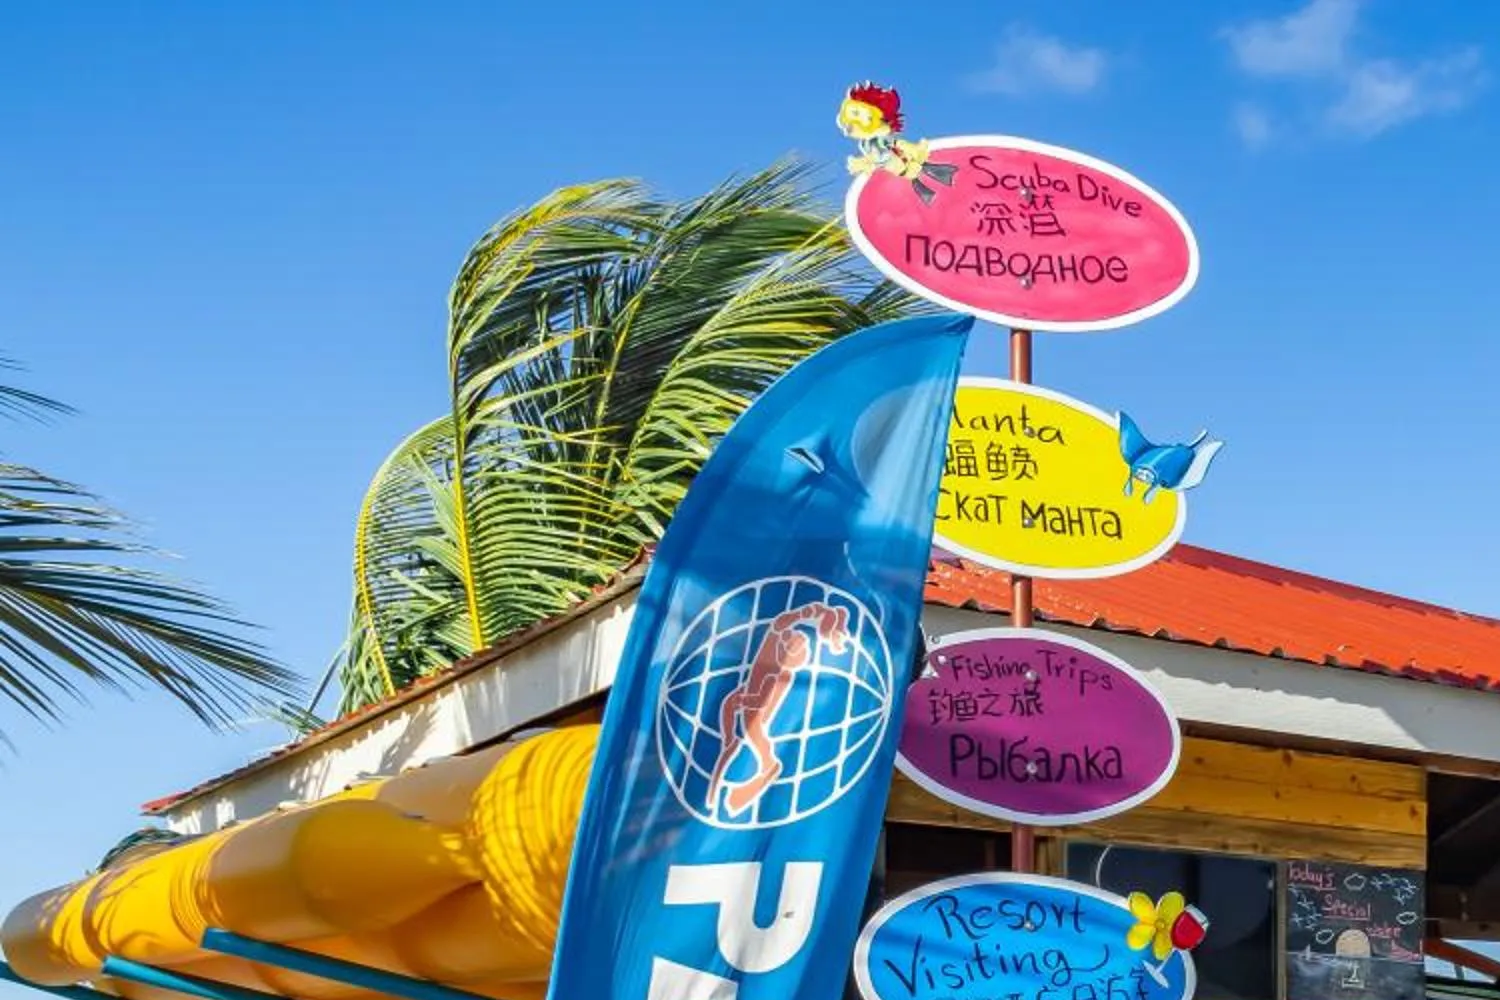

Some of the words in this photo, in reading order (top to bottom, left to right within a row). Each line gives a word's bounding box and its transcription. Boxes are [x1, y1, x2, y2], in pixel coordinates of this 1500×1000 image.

[969, 155, 1071, 193] Scuba
[1077, 173, 1143, 217] Dive
[952, 404, 1065, 445] anta
[951, 655, 1031, 682] Fishing
[1037, 650, 1114, 696] Trips
[950, 734, 1122, 783] Рыбалка
[923, 894, 1086, 940] Resort
[884, 936, 1109, 997] Visiting
